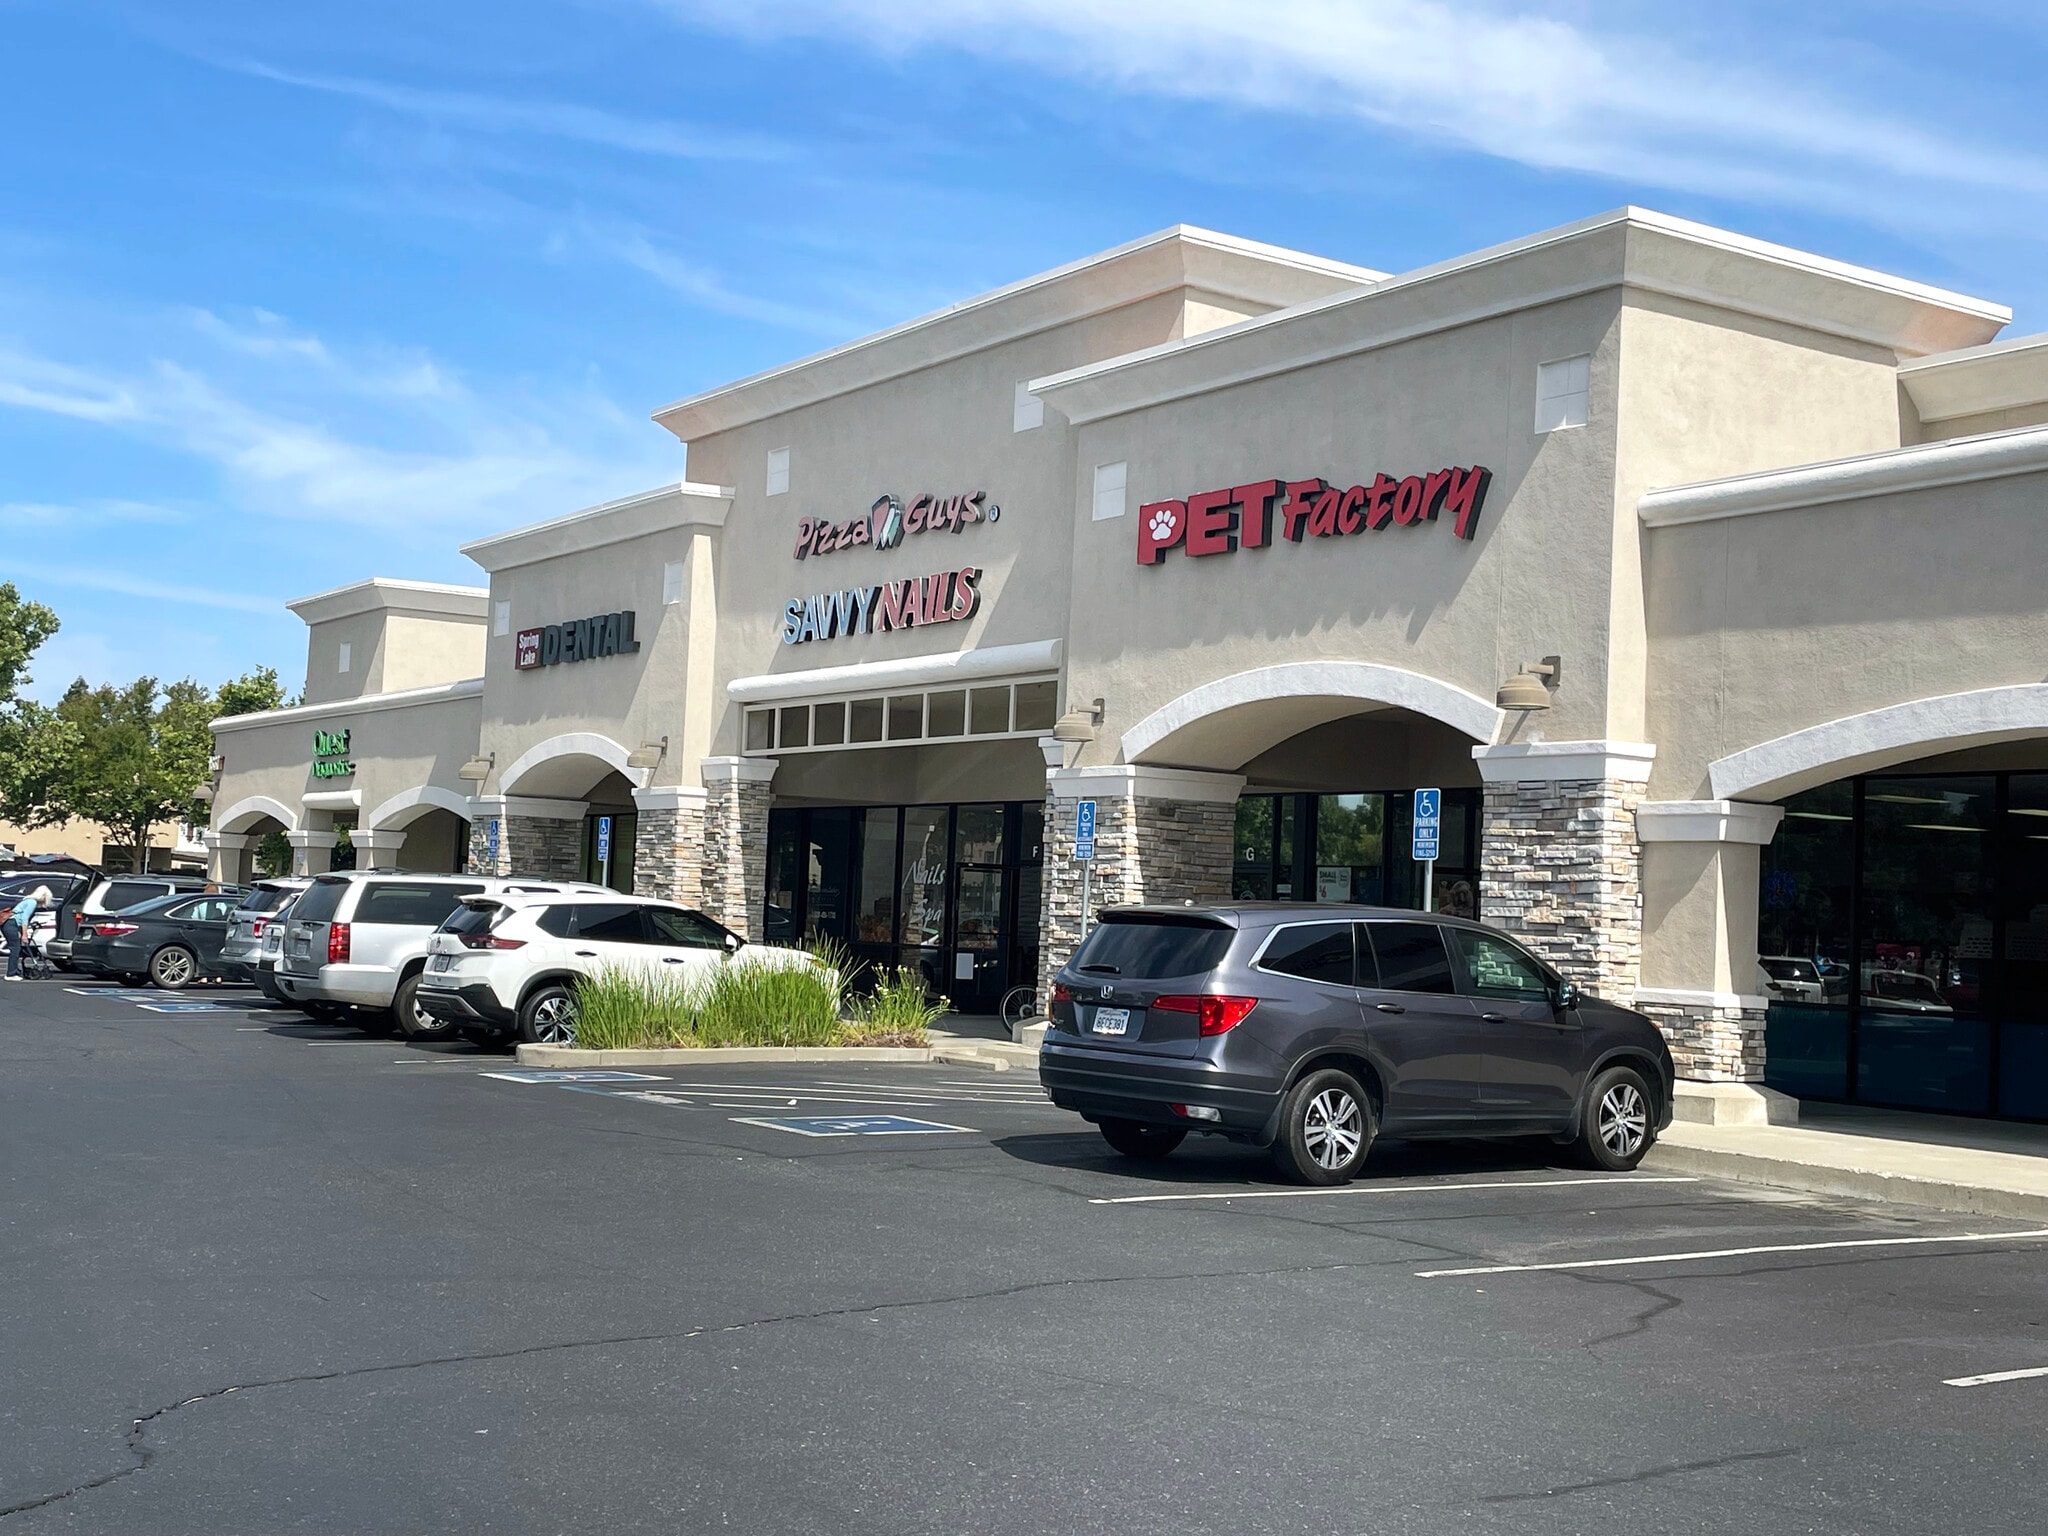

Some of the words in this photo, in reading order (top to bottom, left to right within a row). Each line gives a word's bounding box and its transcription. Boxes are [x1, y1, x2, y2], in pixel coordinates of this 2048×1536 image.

[1137, 479, 1285, 565] PET
[1281, 465, 1493, 541] Factory
[793, 514, 871, 560] Pizza
[783, 587, 878, 645] SAVVY
[877, 566, 983, 633] NAILS
[518, 632, 540, 650] Spring
[543, 611, 641, 666] DENTAL
[519, 651, 536, 666] Lake
[1415, 816, 1438, 827] PARKING
[1418, 828, 1434, 838] ONLY
[1032, 845, 1039, 858] F
[1246, 847, 1255, 862] G
[902, 860, 946, 889] Nails
[908, 898, 942, 928] Spa
